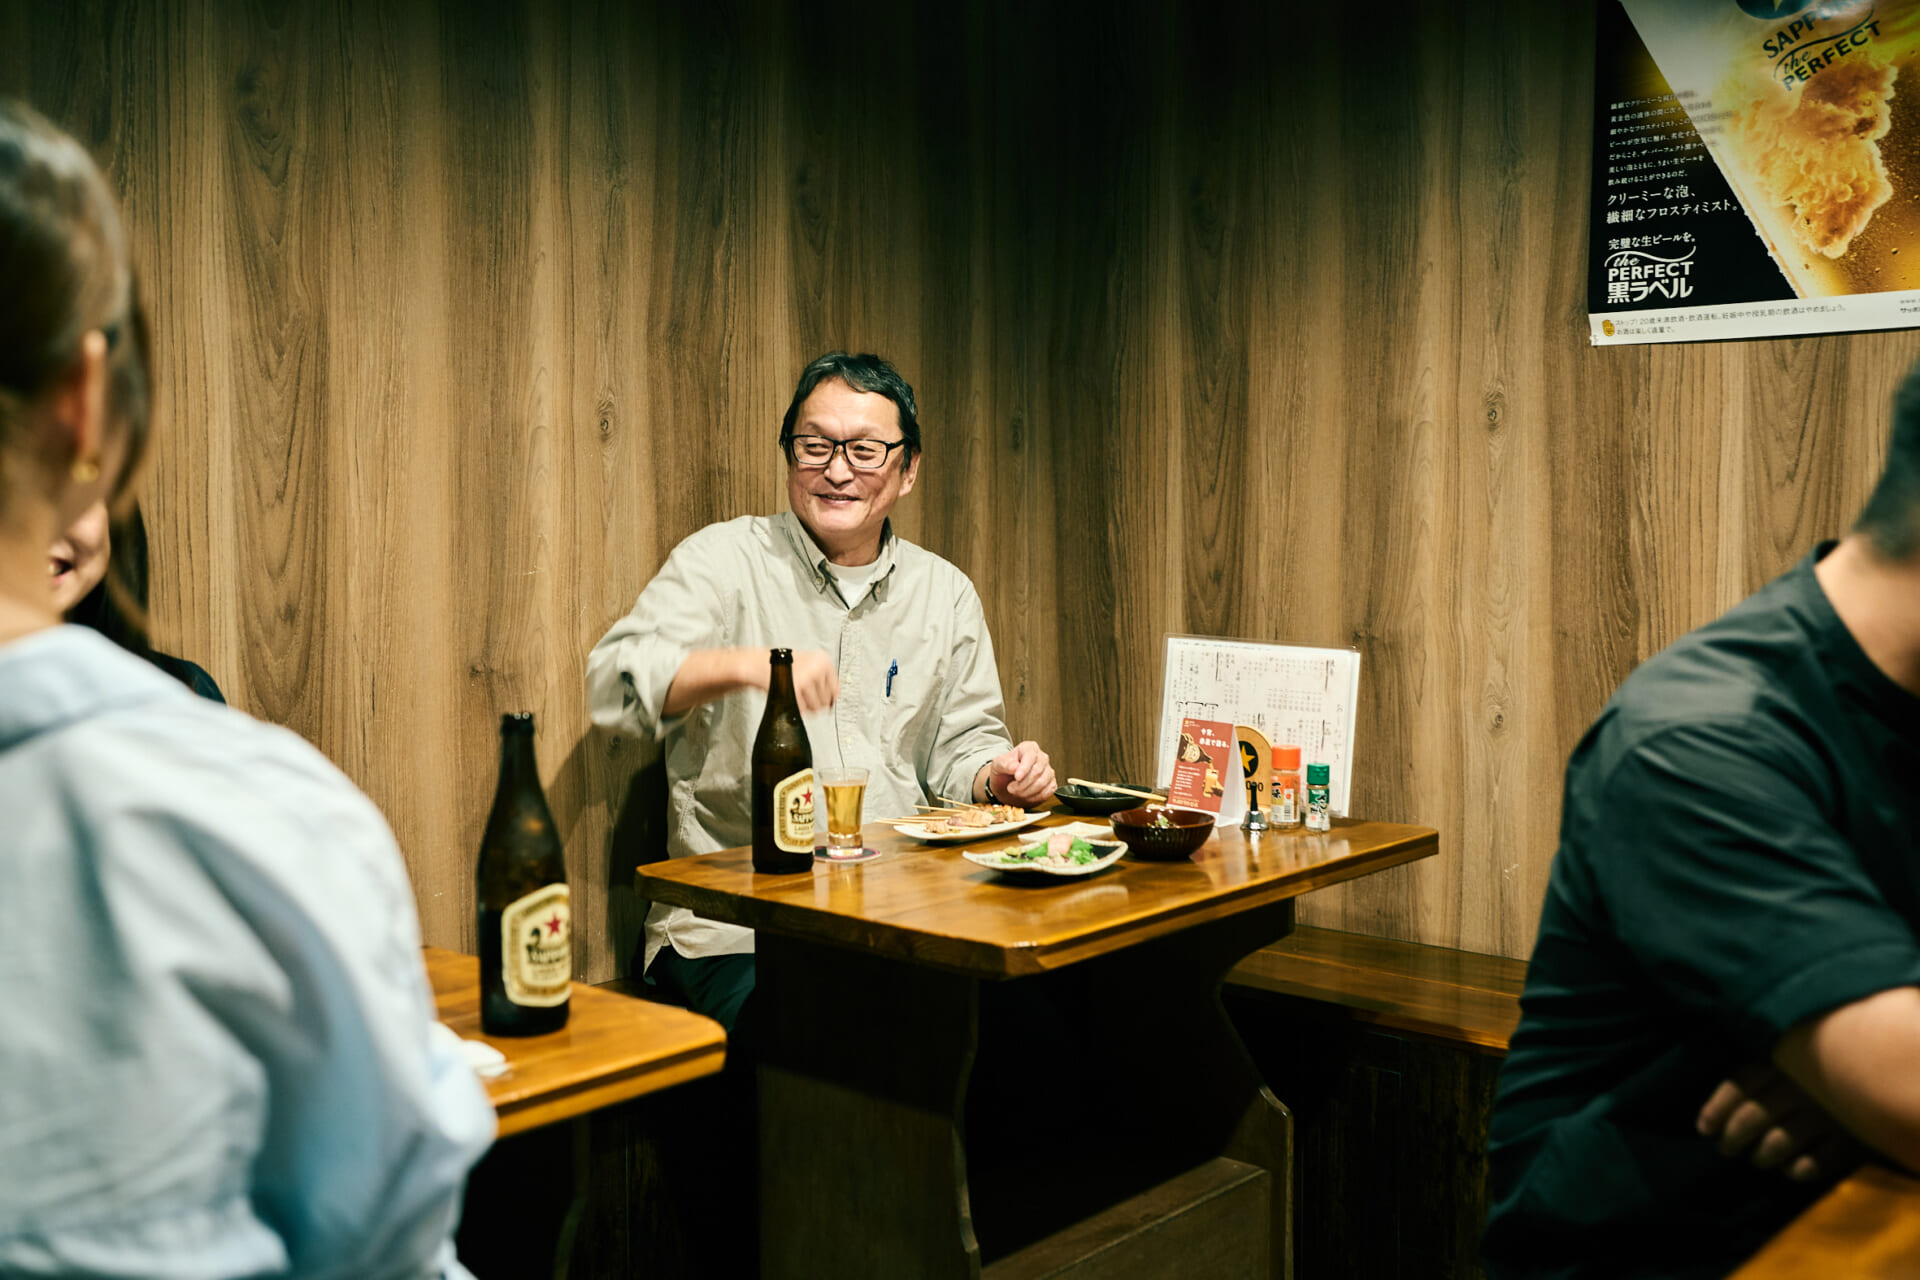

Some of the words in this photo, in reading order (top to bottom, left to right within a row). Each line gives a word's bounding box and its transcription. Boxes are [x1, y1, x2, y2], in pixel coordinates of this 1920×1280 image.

[1782, 20, 1880, 91] PERFECT
[1607, 184, 1696, 206] クリーミーな泡、
[1606, 199, 1738, 224] 繊細なフロスティミスト。
[1608, 232, 1696, 250] 完璧な生ビールを。
[1608, 261, 1694, 282] PERFECT
[1607, 277, 1694, 304] 黒ラベル
